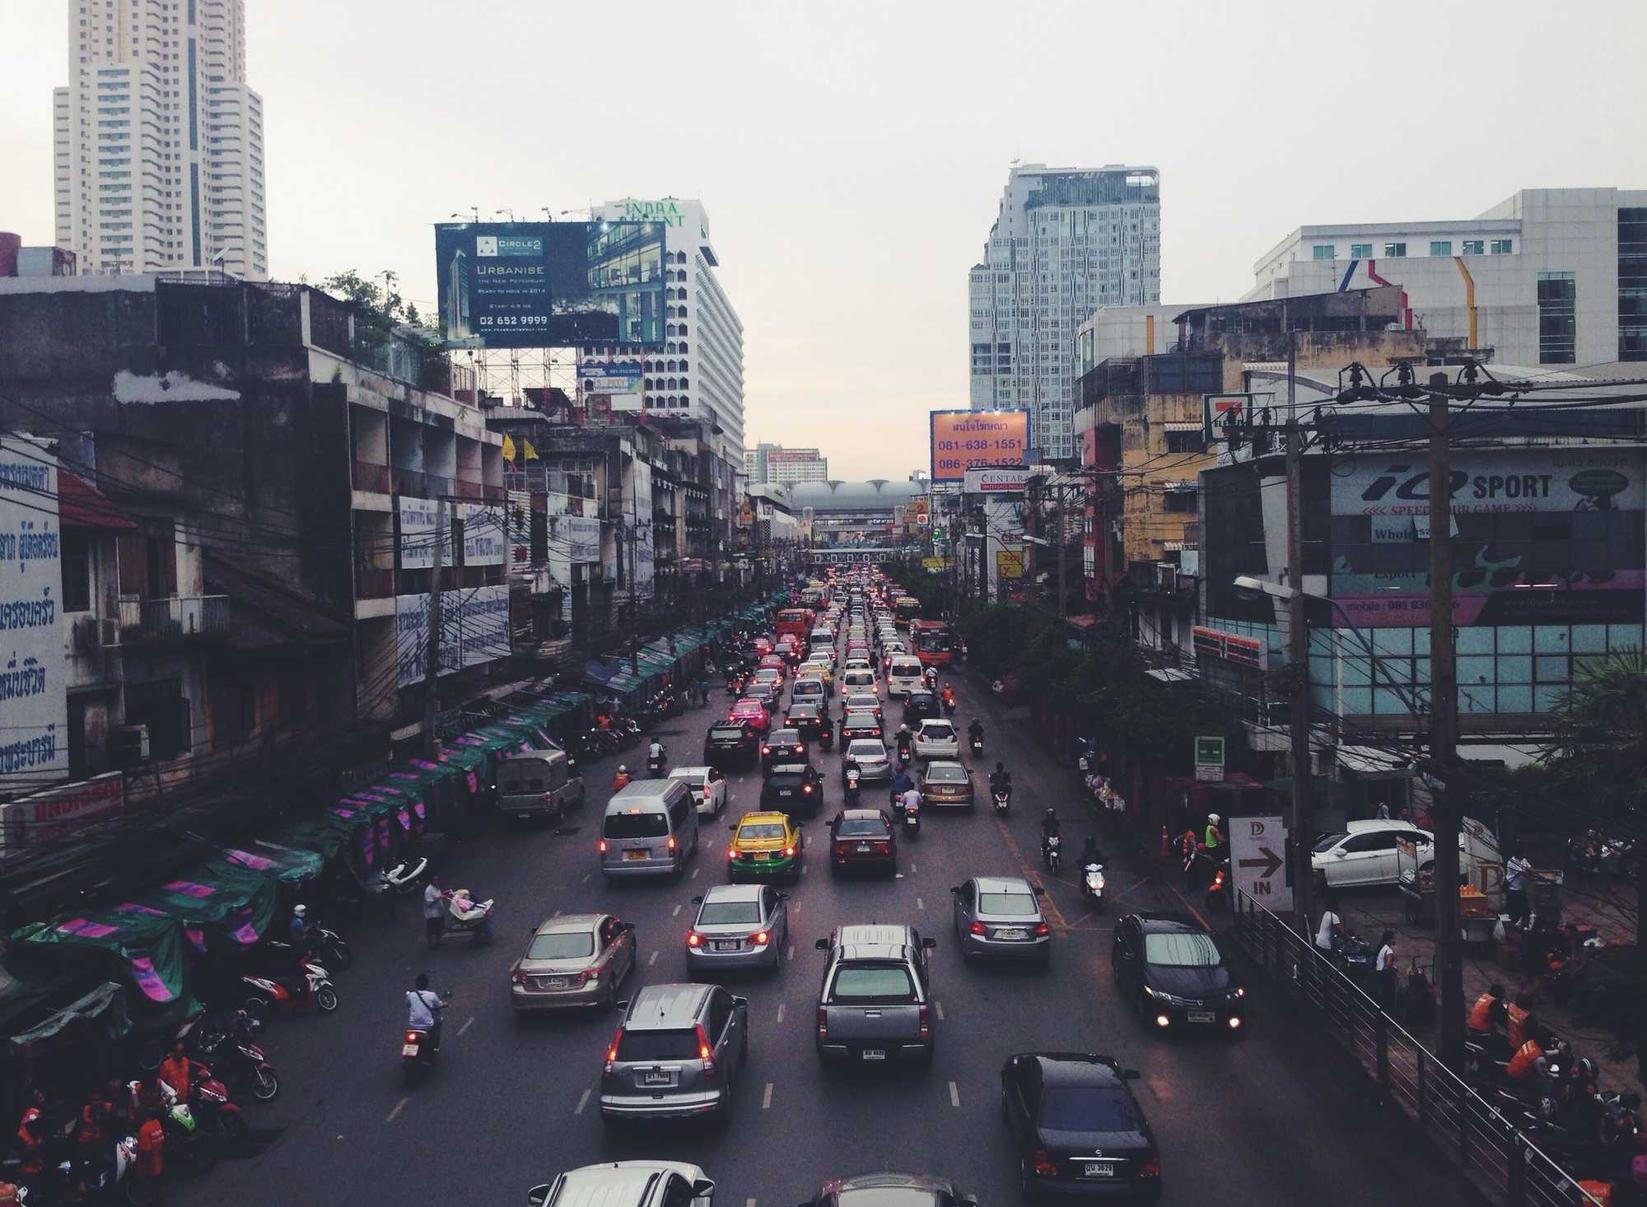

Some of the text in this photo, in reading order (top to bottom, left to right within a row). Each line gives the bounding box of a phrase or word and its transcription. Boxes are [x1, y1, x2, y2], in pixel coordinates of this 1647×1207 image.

[480, 316, 548, 325] 02 652 9999
[938, 439, 1022, 450] 081-638-1551
[1473, 474, 1552, 499] SPORT
[1253, 881, 1271, 895] IN
